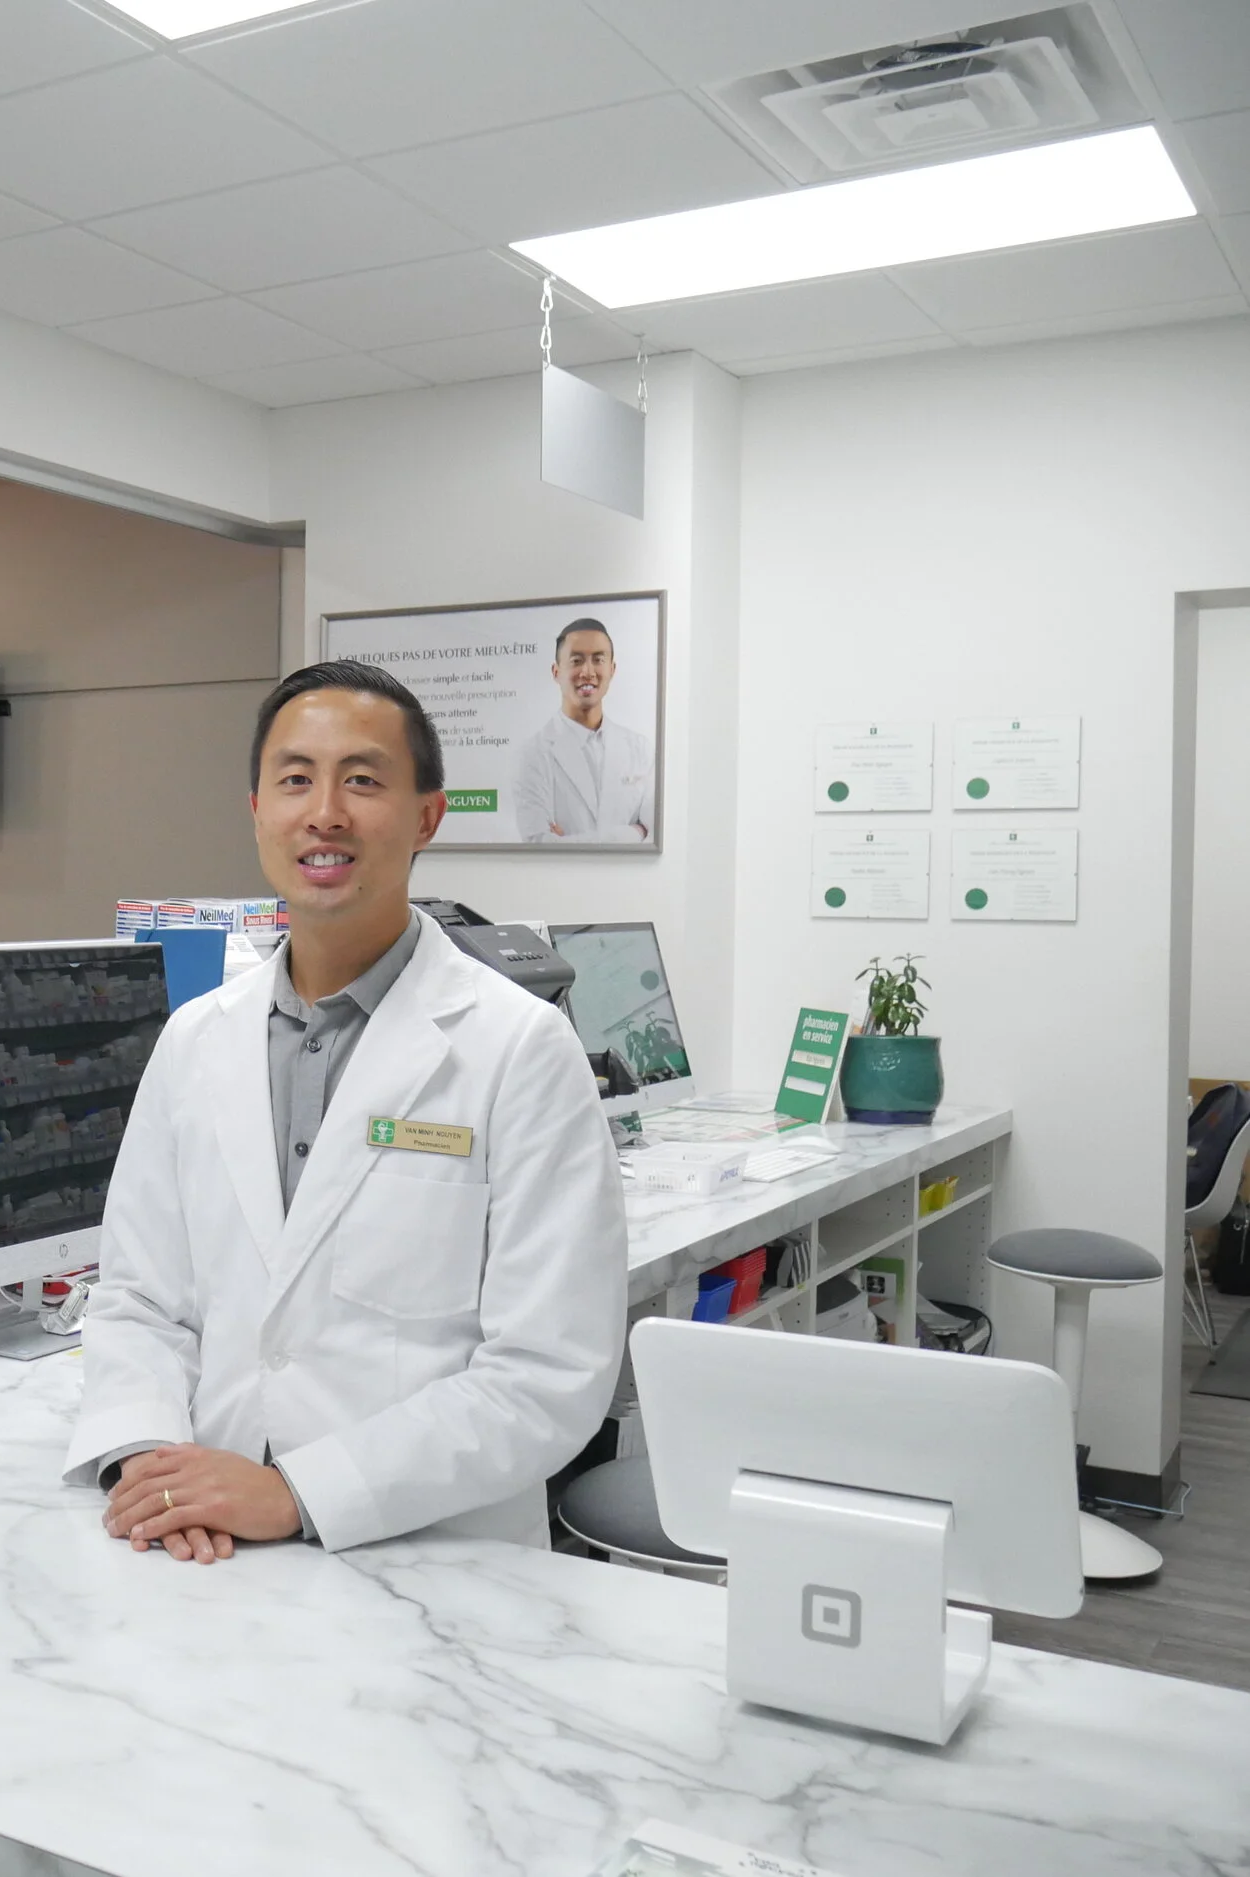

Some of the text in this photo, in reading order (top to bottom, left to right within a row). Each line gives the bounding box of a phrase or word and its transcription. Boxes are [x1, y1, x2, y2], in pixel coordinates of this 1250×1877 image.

[346, 651, 400, 664] QUELQUES
[402, 651, 420, 662] PAS
[423, 651, 437, 660] DE
[437, 647, 472, 660] VOTRE
[474, 641, 538, 657] MIEUX-ÊTRE
[432, 672, 460, 686] simple
[471, 670, 494, 682] facile
[467, 687, 517, 702] prescription
[448, 707, 478, 718] attente
[466, 735, 474, 746] la
[475, 735, 510, 748] clinique
[446, 795, 491, 807] NGUYEN
[200, 908, 234, 922] NeilMed
[243, 902, 275, 915] NeilMed
[802, 1014, 839, 1031] pharmacien
[802, 1031, 833, 1045] en service
[418, 1128, 434, 1137] MINH
[436, 1131, 462, 1140] NGUYEN
[413, 1139, 451, 1150] Pharmacien
